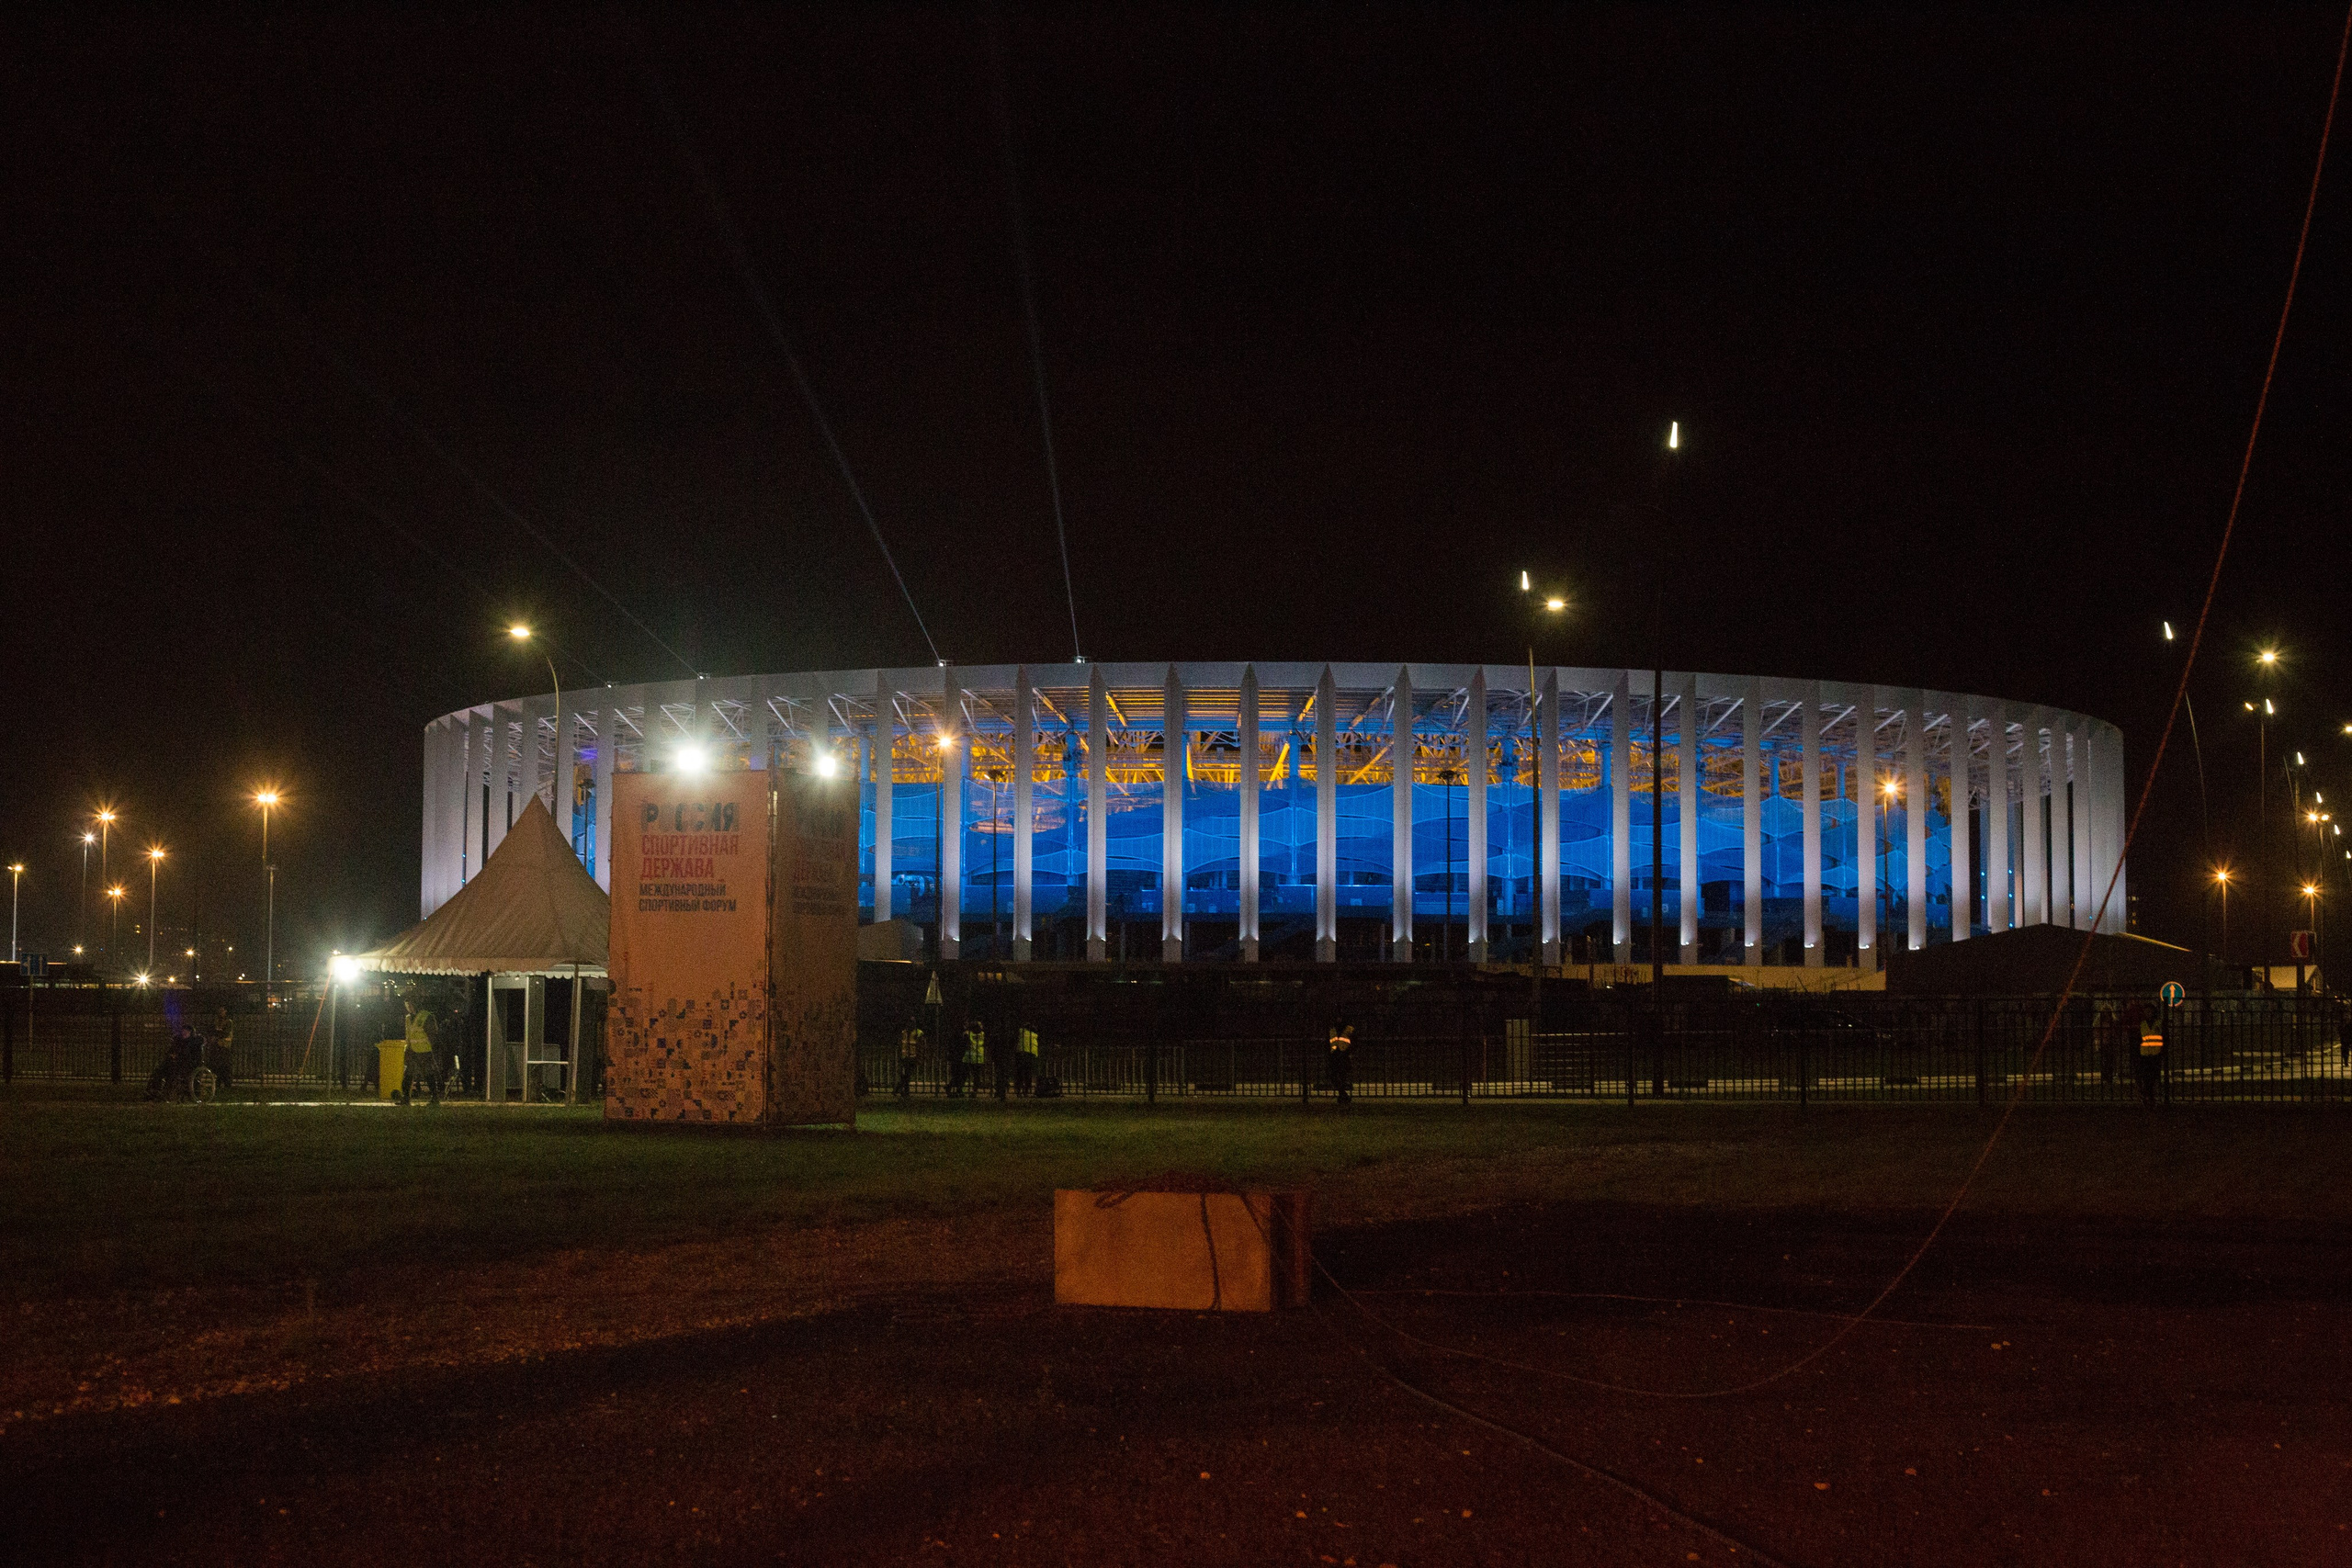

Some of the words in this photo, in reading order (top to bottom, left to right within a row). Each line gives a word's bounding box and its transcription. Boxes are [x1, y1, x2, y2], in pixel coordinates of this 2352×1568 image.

[642, 834, 739, 855] СПОРТИВНАЯ
[640, 857, 714, 880] ДЕРЖАВА
[639, 881, 727, 897] МЕЖДУНАРОДНЫЙ
[702, 898, 737, 912] ФОРУМ
